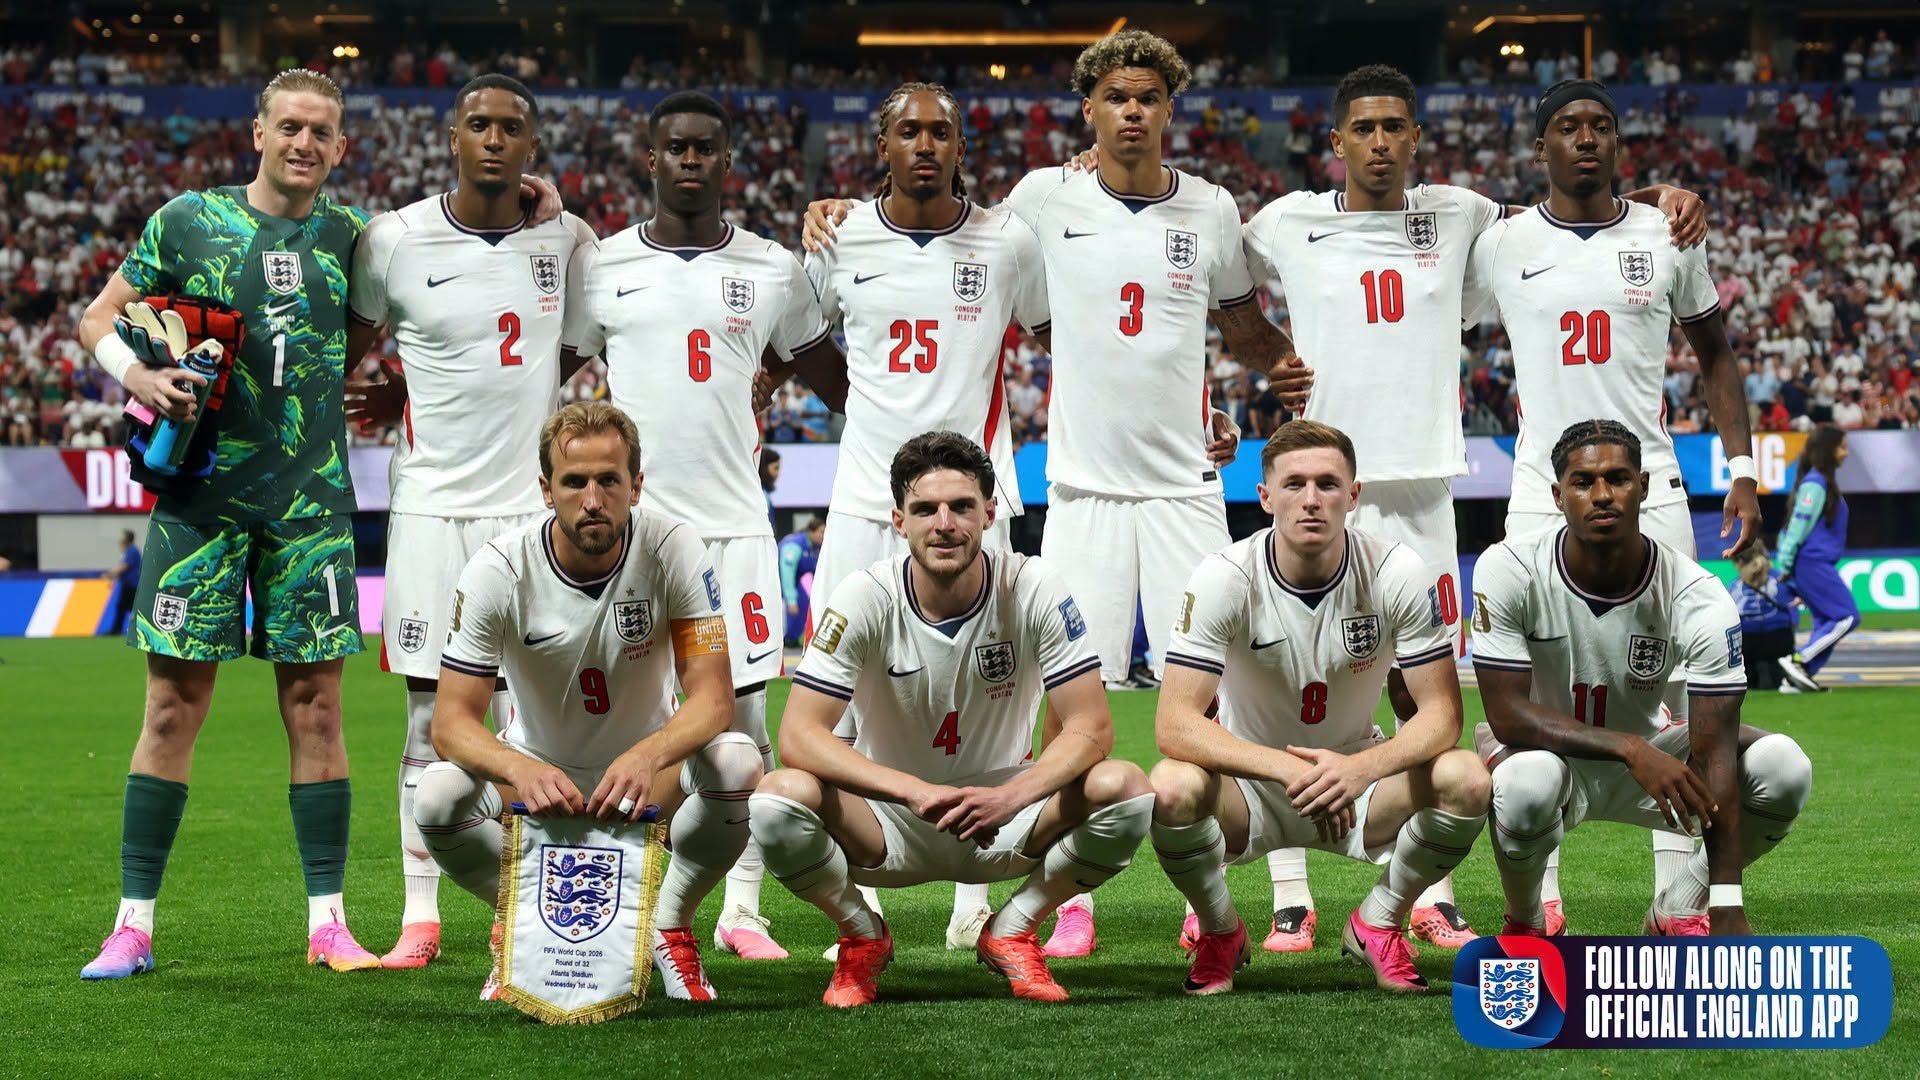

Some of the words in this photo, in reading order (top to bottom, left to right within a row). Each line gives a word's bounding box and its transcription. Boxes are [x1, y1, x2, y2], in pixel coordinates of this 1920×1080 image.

[1167, 272, 1186, 280] CONGO
[1360, 269, 1404, 323] 10
[726, 316, 744, 324] CONGO
[954, 305, 974, 313] CONGO
[1119, 282, 1144, 336] 3
[272, 333, 286, 387] 1
[498, 312, 523, 367] 2
[687, 329, 712, 383] 6
[889, 319, 938, 373] 25
[1560, 310, 1611, 366] 20
[86, 449, 143, 508] DR
[323, 564, 340, 616] 1
[695, 623, 726, 636] UNITES
[741, 591, 770, 644] 6
[624, 645, 644, 654] CONGO
[579, 667, 611, 715] 9
[985, 684, 1006, 694] CONGO
[1301, 682, 1328, 725] 8
[1572, 682, 1608, 728] 11
[932, 711, 961, 756] 4
[555, 959, 573, 967] Round
[582, 960, 590, 968] 32
[557, 948, 574, 956] World
[576, 949, 587, 957] Cup
[571, 971, 593, 979] Stadium
[545, 980, 576, 989] Wednesday
[578, 981, 586, 989] 1st
[587, 982, 598, 990] July
